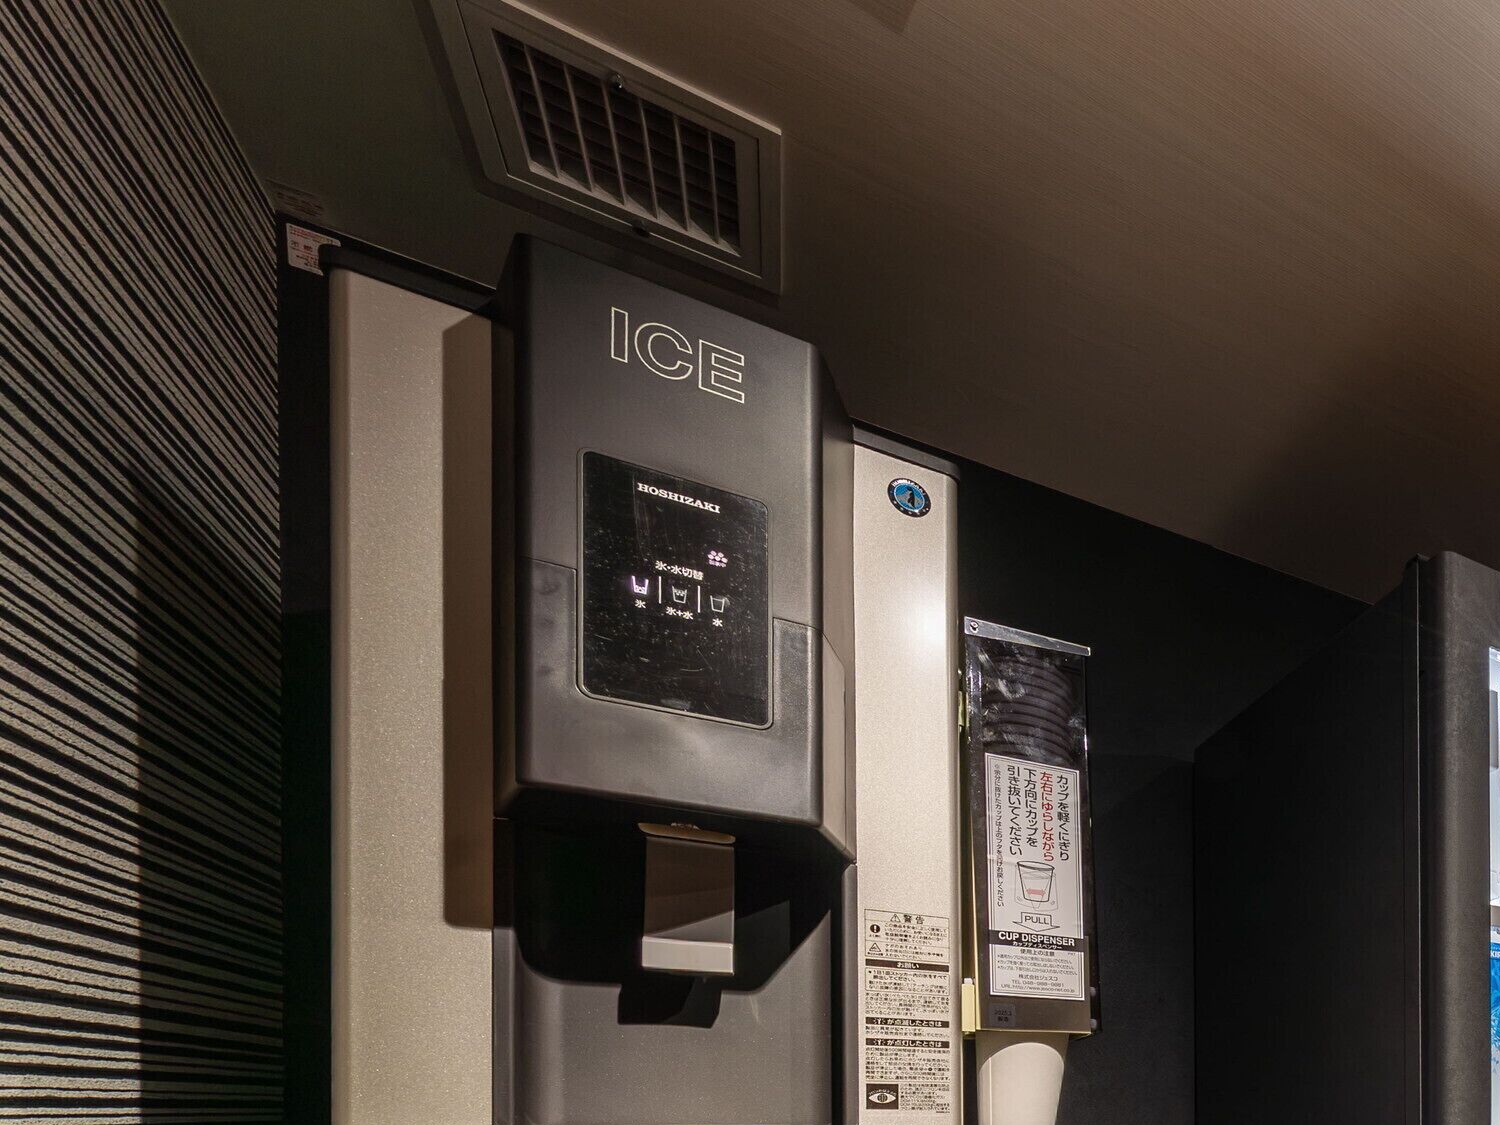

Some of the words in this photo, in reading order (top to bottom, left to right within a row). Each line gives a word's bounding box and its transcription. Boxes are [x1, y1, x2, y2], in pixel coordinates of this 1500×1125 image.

[611, 306, 745, 404] ICE
[637, 482, 721, 514] HOSHIZAKI
[655, 560, 704, 581] 氷・水切替
[635, 599, 646, 609] 氷
[665, 606, 694, 620] 氷+水
[712, 618, 723, 627] 水
[1007, 765, 1022, 856] 引き抜いてください
[1023, 767, 1038, 848] 下方向にカップを
[1040, 771, 1054, 861] 左右にゆらしながら
[1056, 775, 1070, 861] カップを軽くにぎり
[1024, 915, 1049, 925] PULL
[998, 931, 1019, 940] CUP
[1021, 933, 1075, 946] DISPENSER
